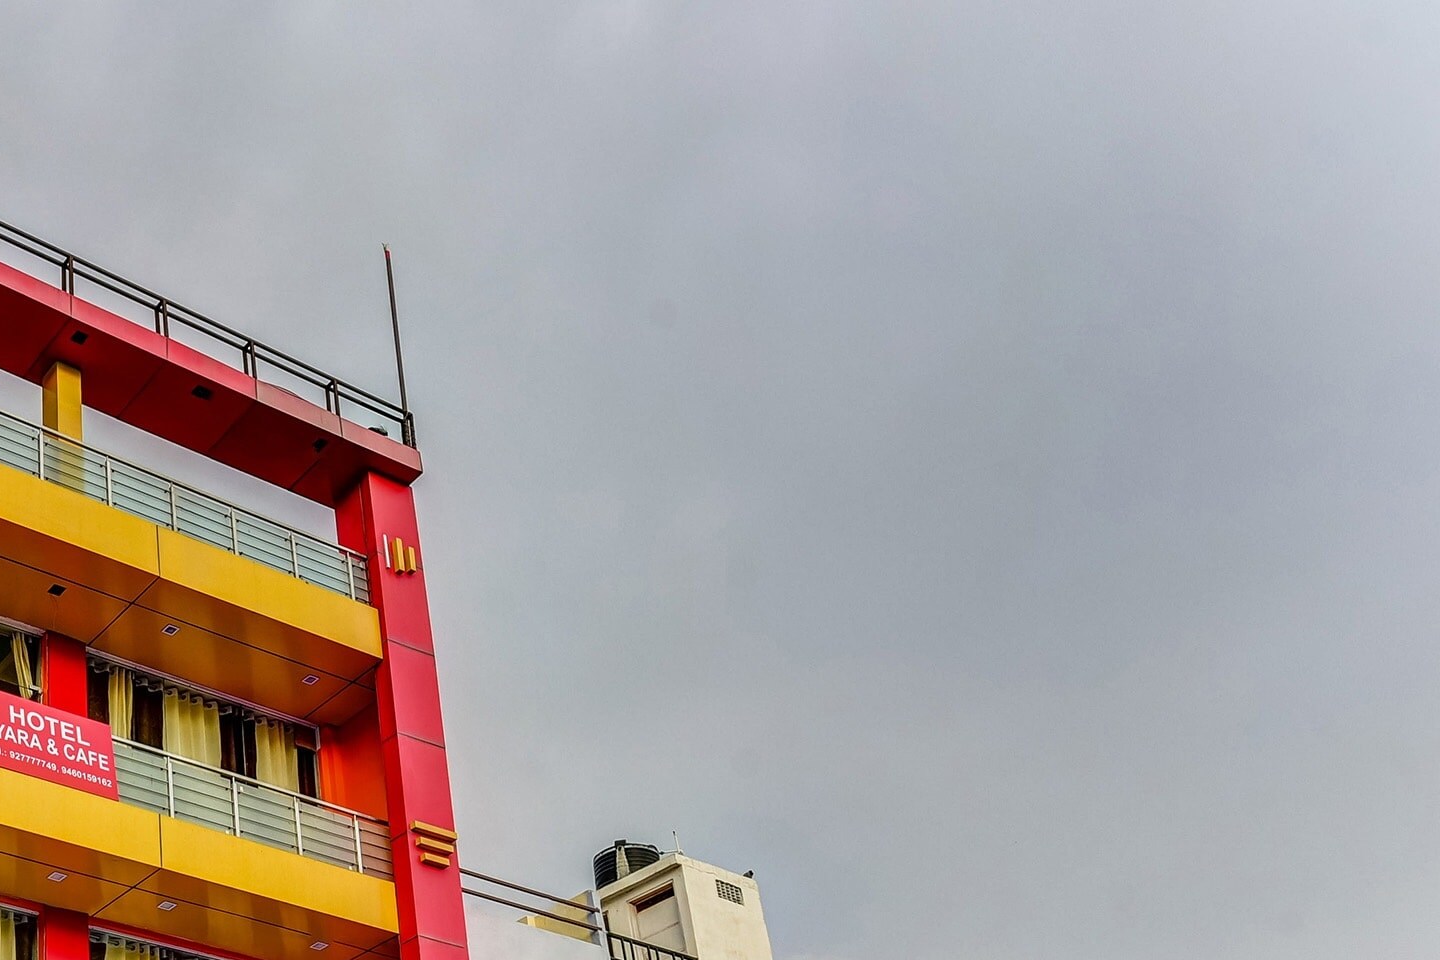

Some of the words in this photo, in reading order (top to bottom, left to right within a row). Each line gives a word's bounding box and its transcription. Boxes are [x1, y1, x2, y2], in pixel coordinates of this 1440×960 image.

[9, 704, 91, 747] HOTEL
[46, 738, 59, 757] &
[63, 744, 110, 772] CAFE
